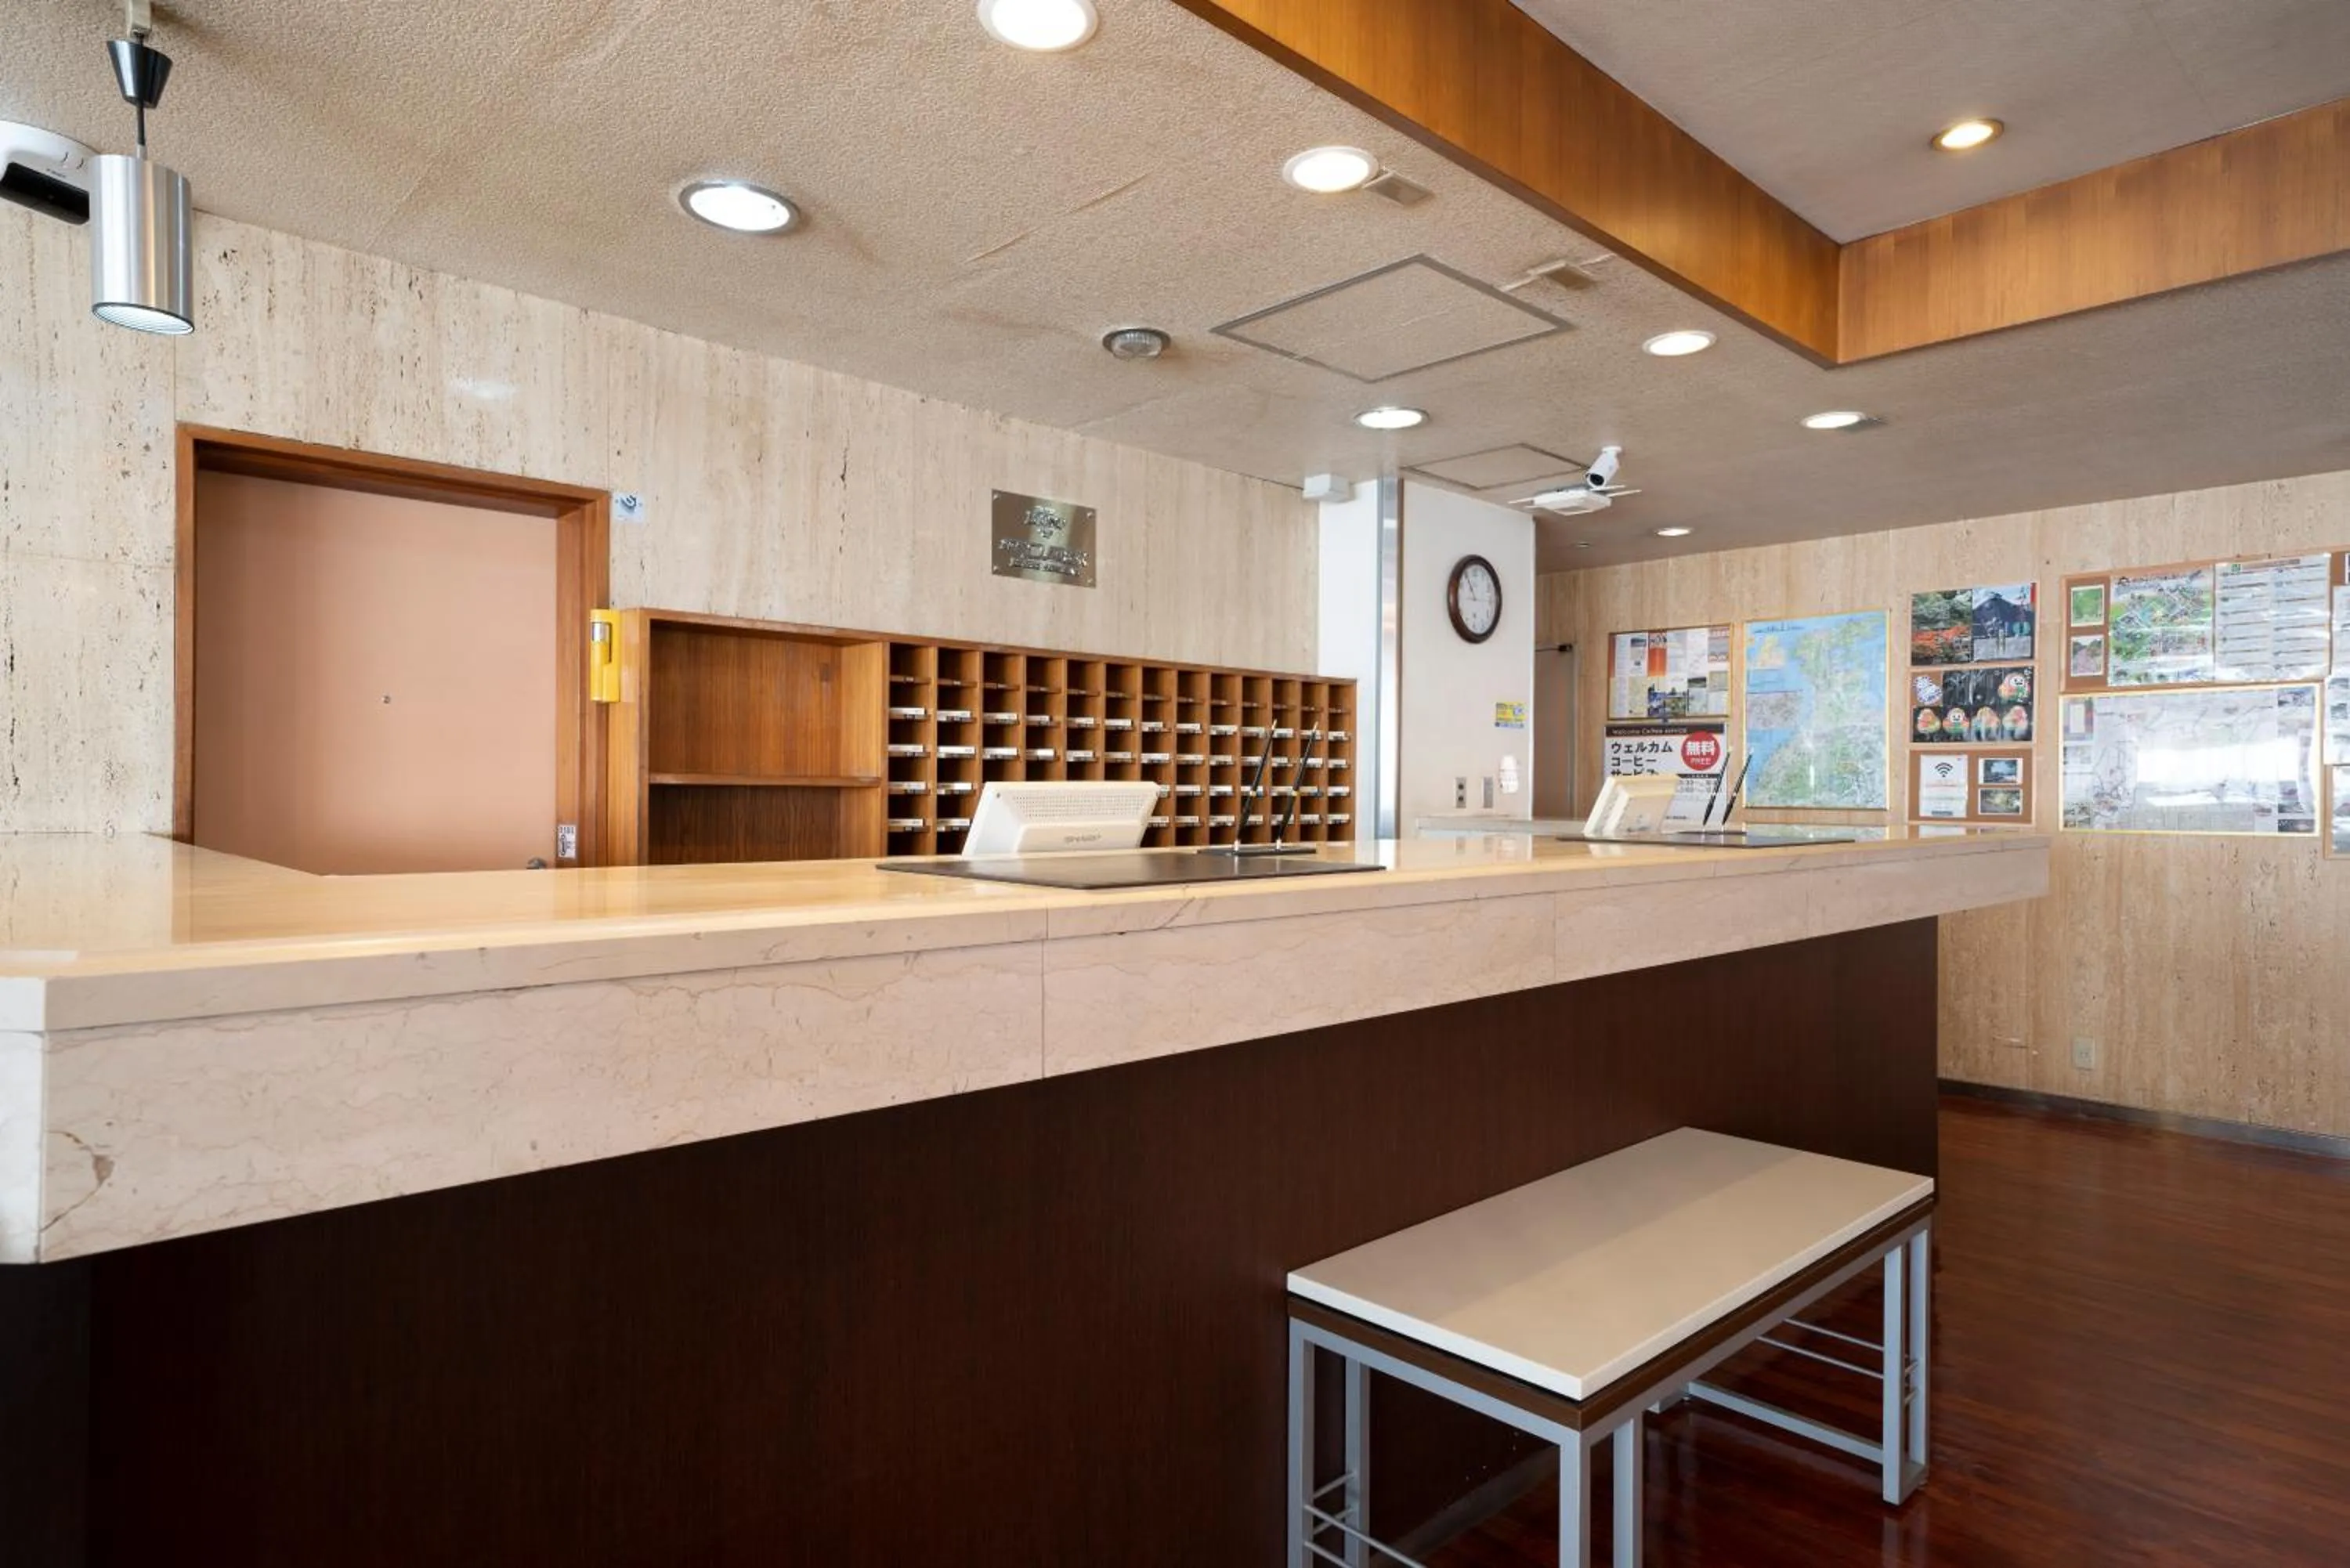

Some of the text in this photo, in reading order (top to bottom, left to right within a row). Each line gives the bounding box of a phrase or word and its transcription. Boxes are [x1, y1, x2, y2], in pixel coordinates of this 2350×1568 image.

[1611, 740, 1673, 753] ウェルカム
[1687, 740, 1715, 756] 無料
[1611, 755, 1657, 767] コーヒー
